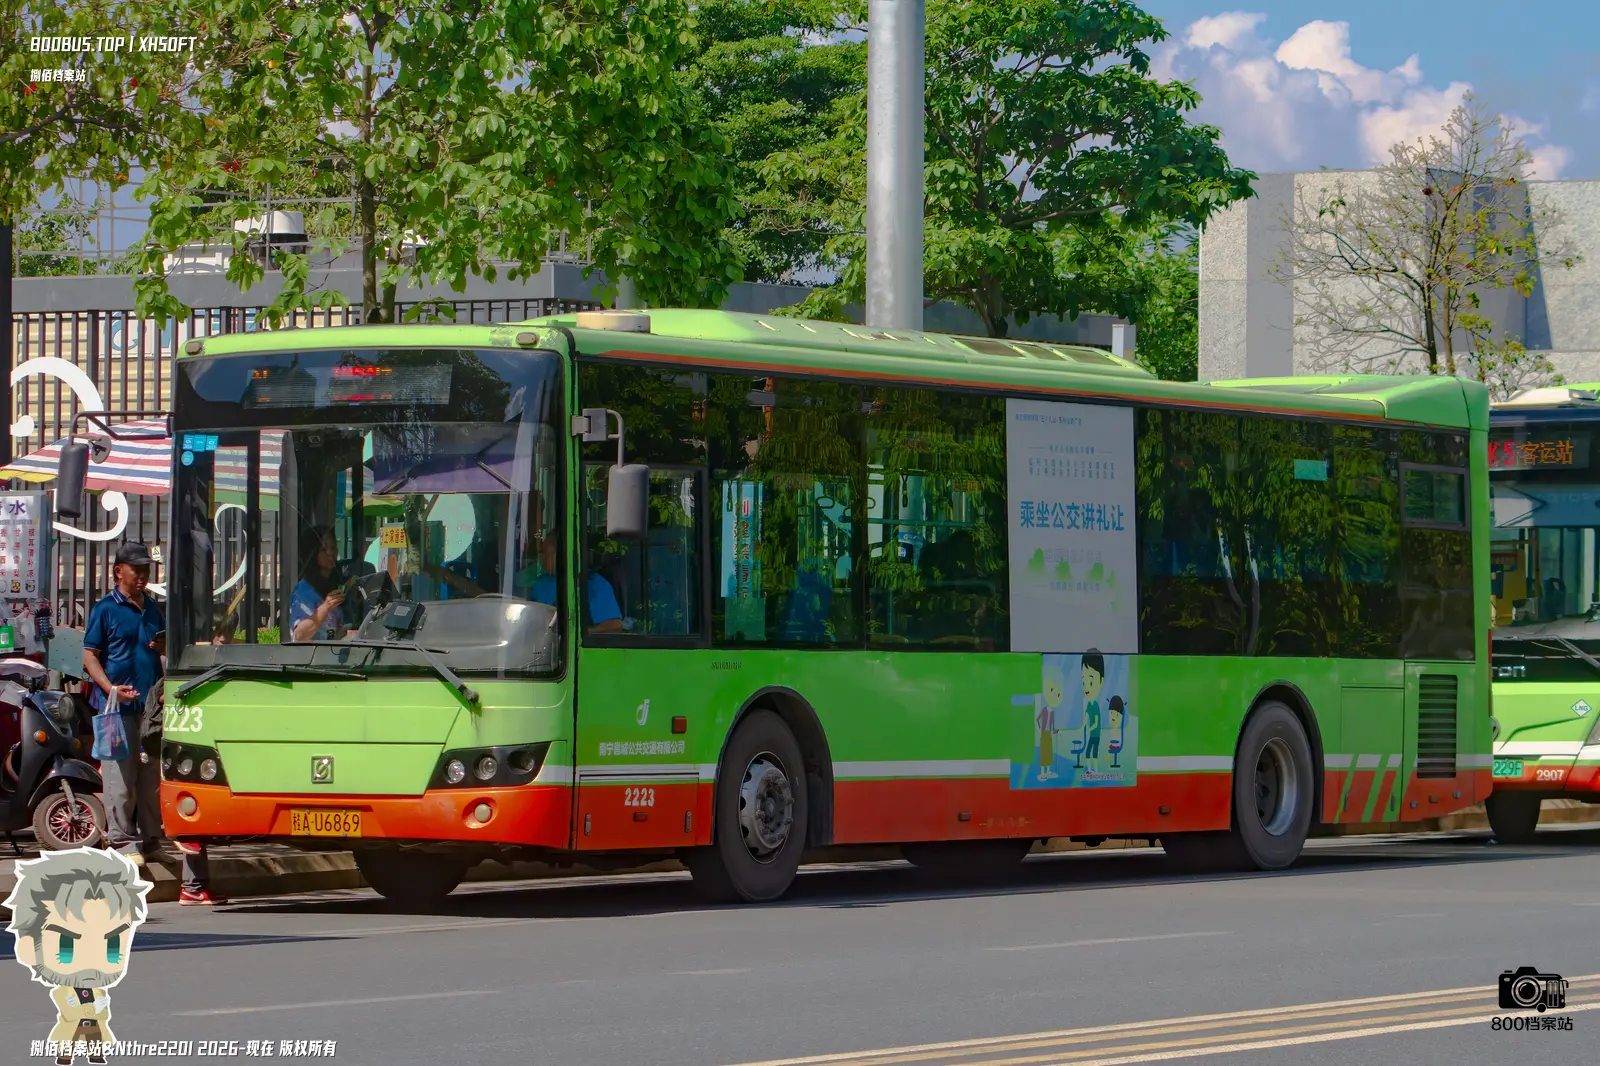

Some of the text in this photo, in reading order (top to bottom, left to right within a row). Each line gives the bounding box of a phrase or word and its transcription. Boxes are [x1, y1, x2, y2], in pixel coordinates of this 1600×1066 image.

[1020, 501, 1125, 531] 乘坐公交讲礼让
[164, 706, 203, 732] 2223
[1536, 769, 1565, 781] 2907
[624, 787, 655, 806] 2223
